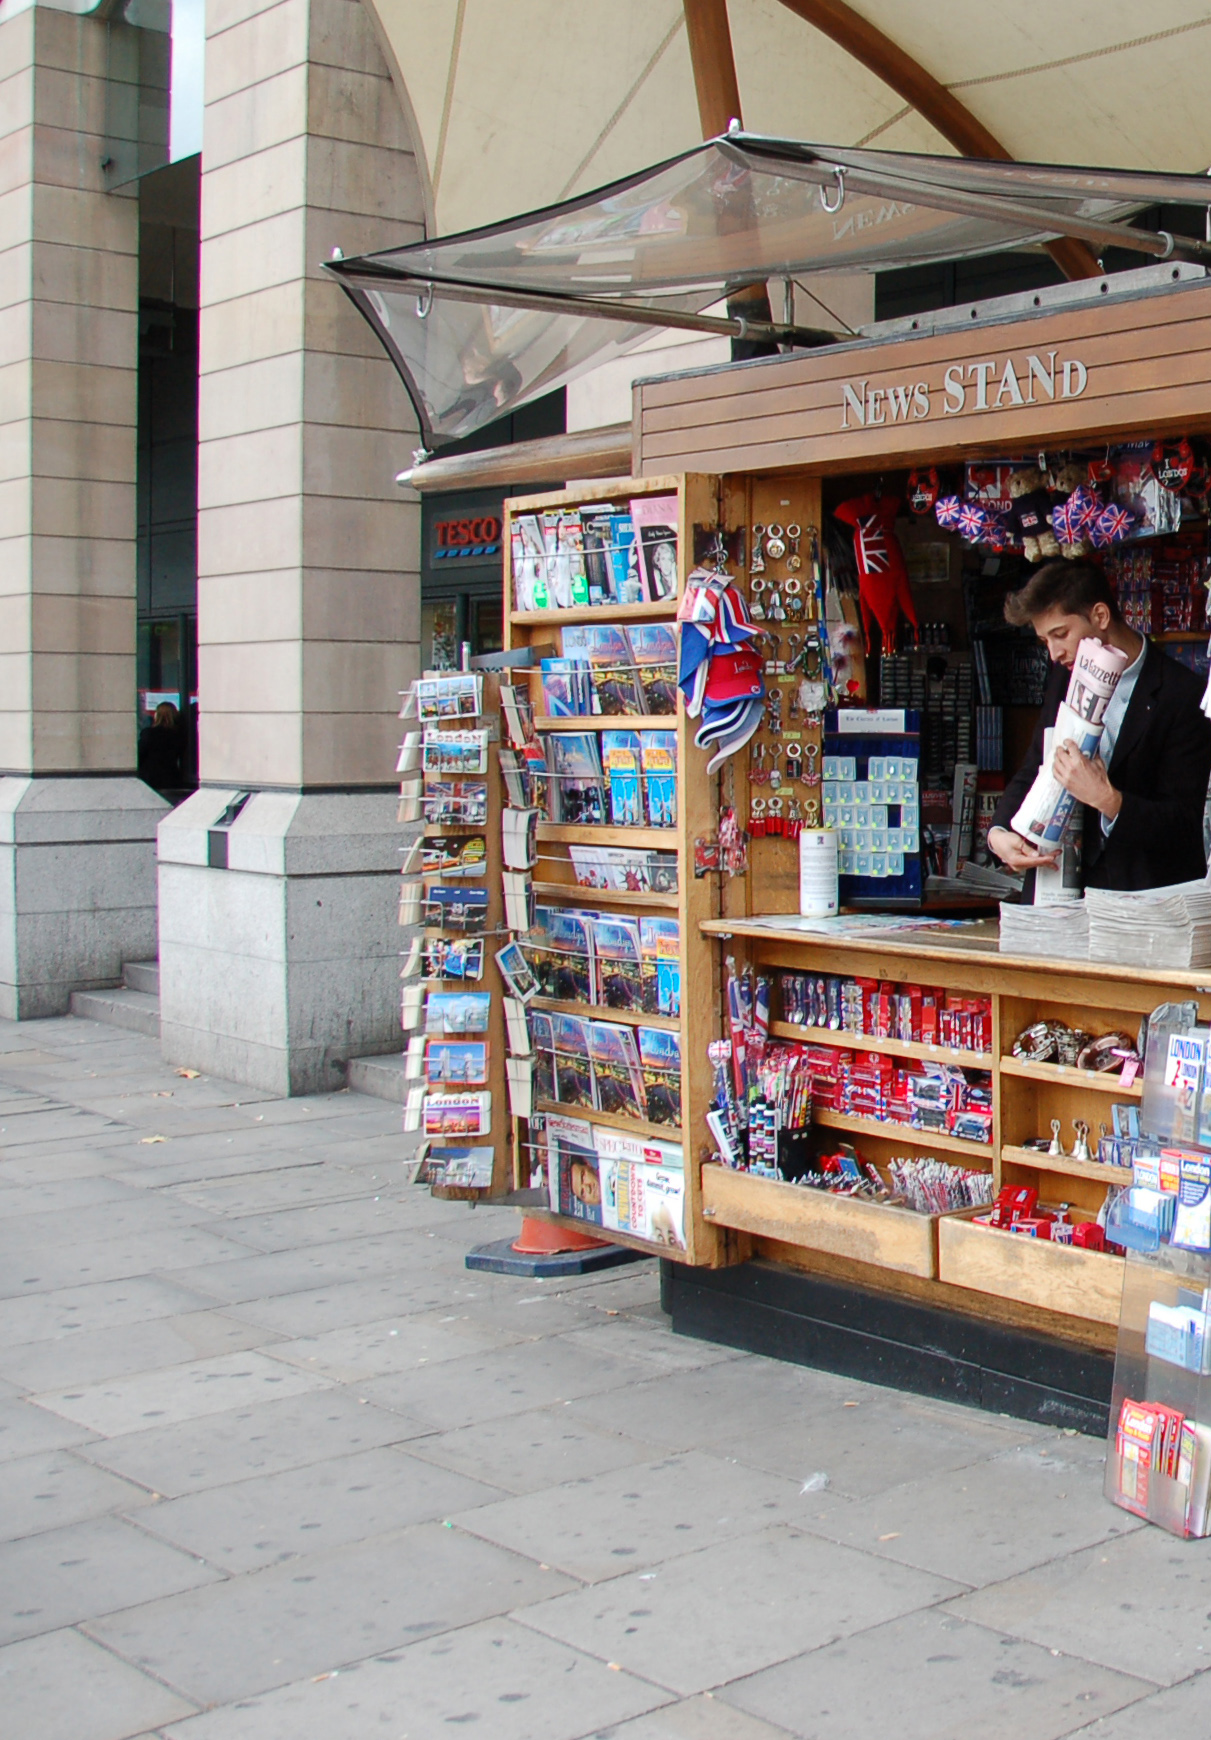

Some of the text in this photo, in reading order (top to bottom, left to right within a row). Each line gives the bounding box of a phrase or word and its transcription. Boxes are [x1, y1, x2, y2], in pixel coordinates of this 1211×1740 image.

[943, 351, 1089, 414] STAND
[434, 516, 499, 546] TESCO
[1170, 1038, 1202, 1061] LONDON
[1180, 1159, 1211, 1178] London
[630, 1163, 638, 1230] COUNTDOWN
